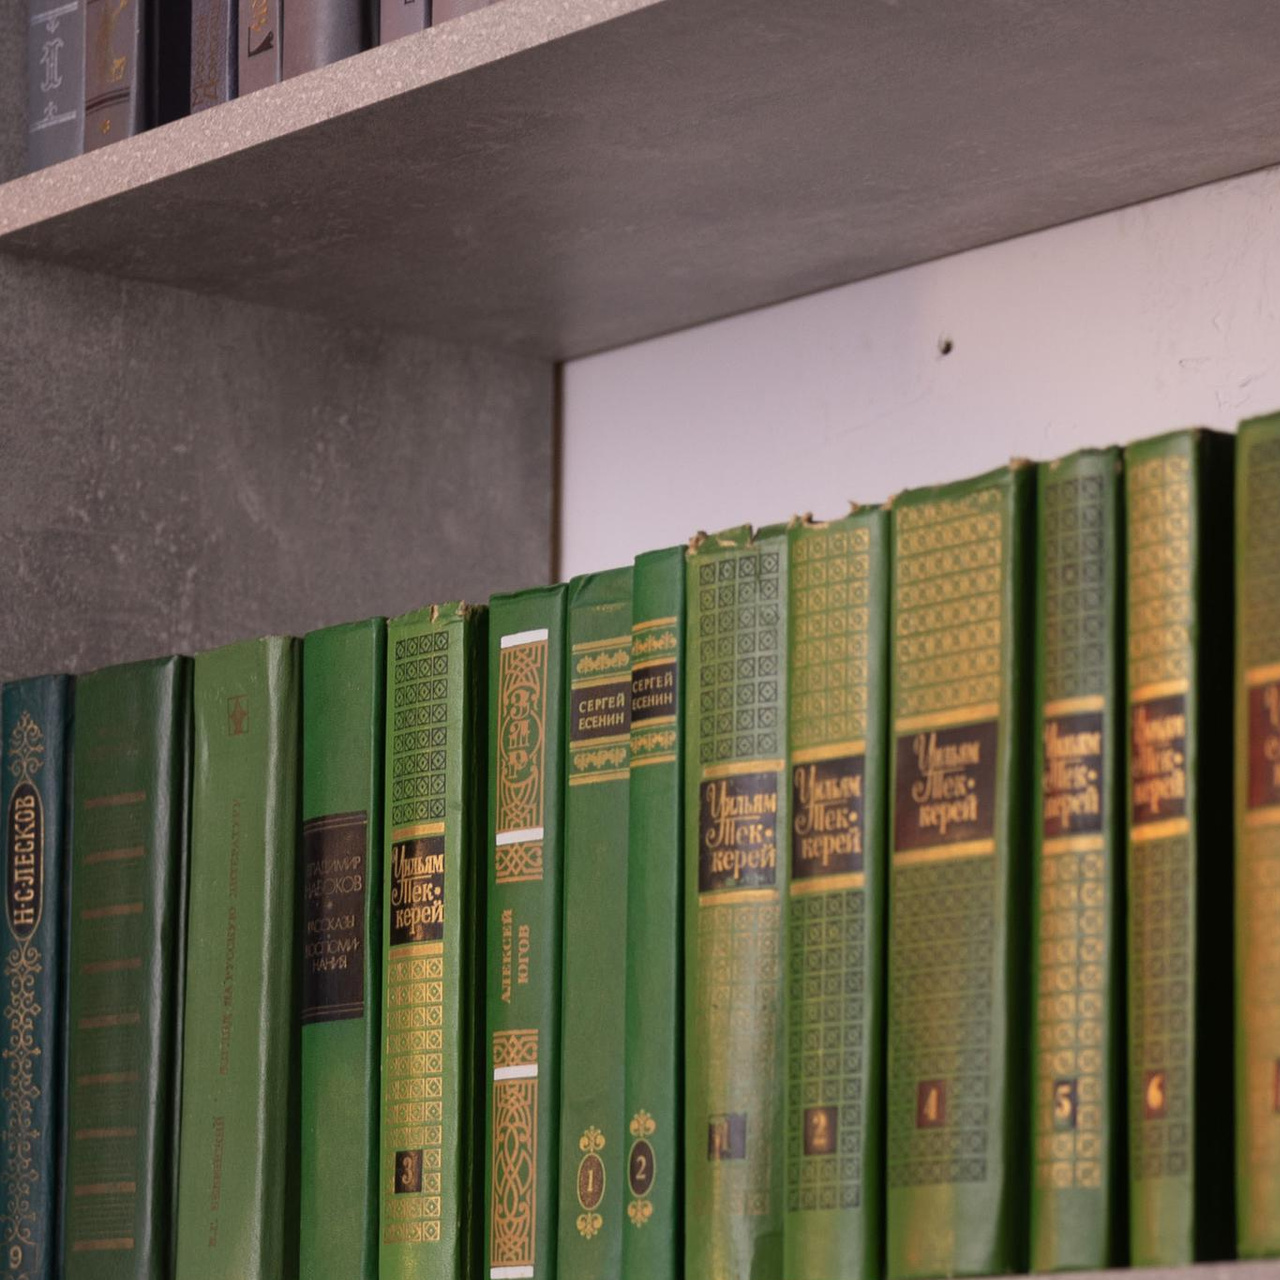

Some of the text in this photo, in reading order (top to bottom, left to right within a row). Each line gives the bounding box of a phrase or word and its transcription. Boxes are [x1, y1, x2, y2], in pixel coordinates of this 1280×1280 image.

[632, 674, 673, 694] СЕРГЕЙ
[578, 693, 626, 714] СЕРГЕЙ
[632, 692, 673, 711] ЕСЕНИН
[578, 712, 625, 731] ЕСЕНИН
[706, 780, 776, 819] Уильям
[919, 794, 978, 835] керей
[392, 845, 444, 878] Уильям
[710, 844, 776, 880] керей
[800, 825, 862, 867] керей
[396, 900, 444, 935] керей
[500, 908, 514, 1005] АЛЕКСЕЙ
[516, 923, 530, 985] ЮГОВ
[812, 1111, 829, 1146] 2
[401, 1157, 414, 1185] 3
[586, 1169, 595, 1192] 1
[635, 1156, 646, 1181] 2
[10, 1244, 23, 1270] 9
